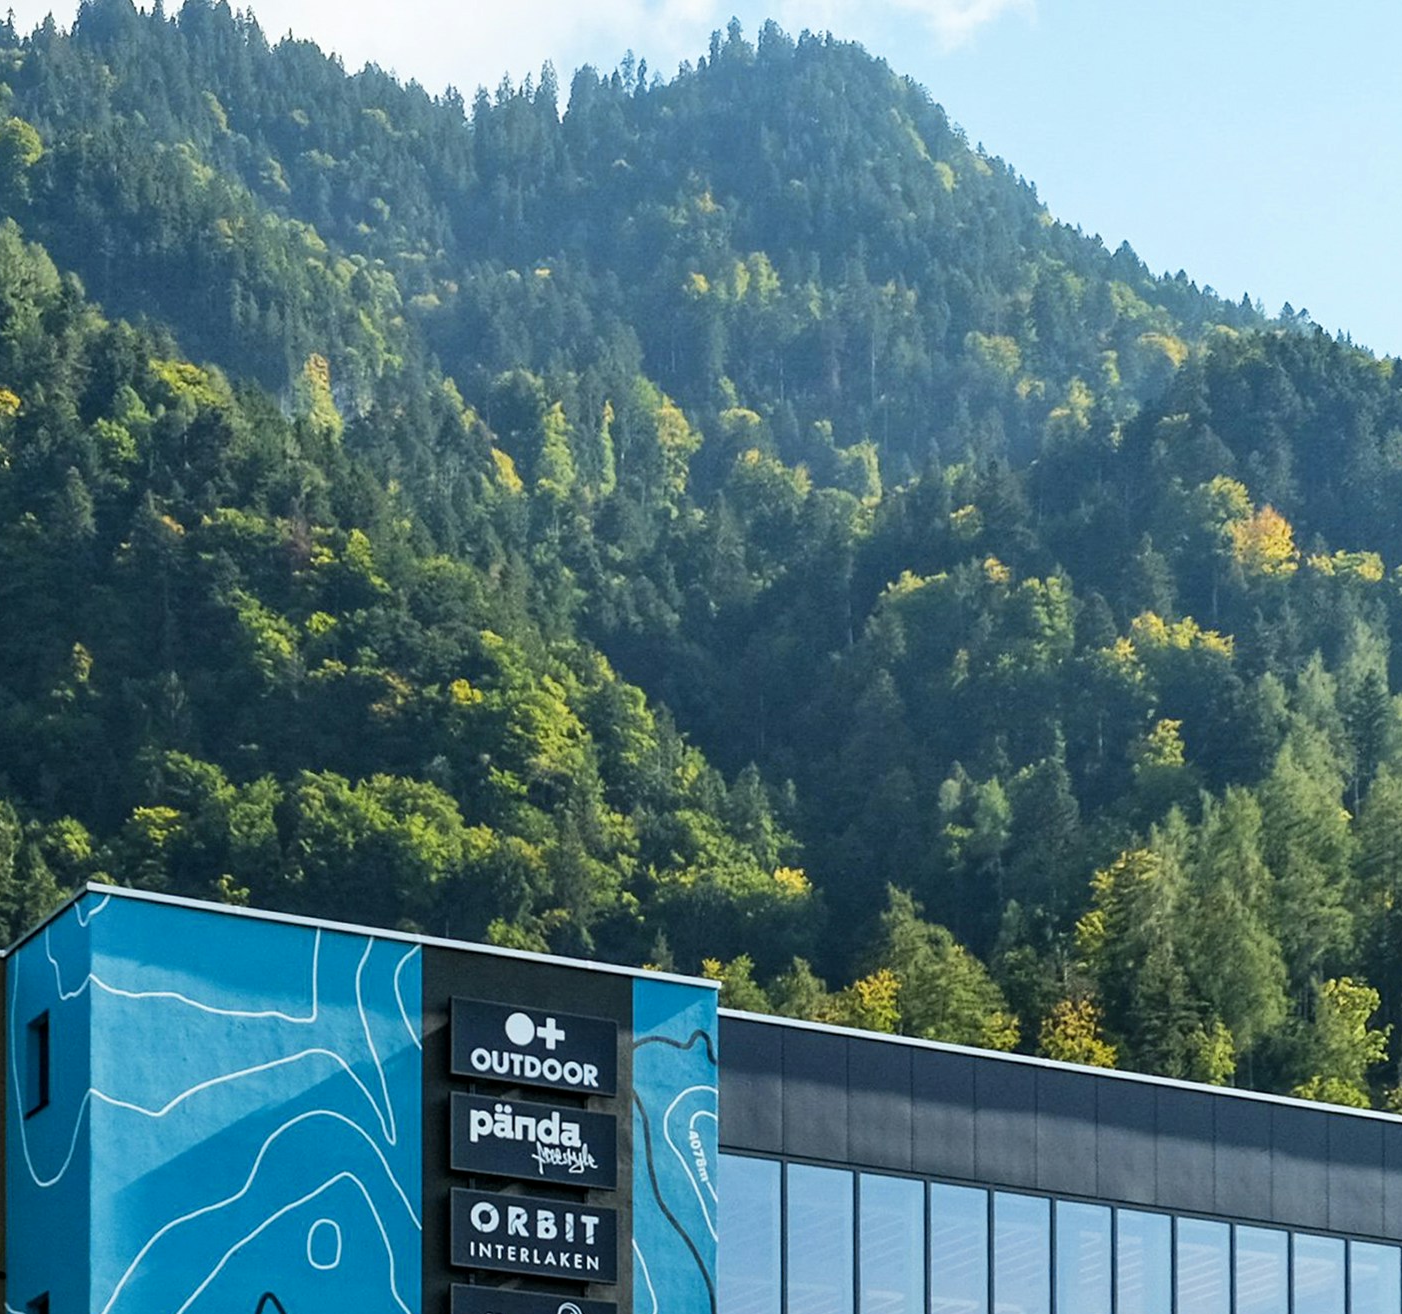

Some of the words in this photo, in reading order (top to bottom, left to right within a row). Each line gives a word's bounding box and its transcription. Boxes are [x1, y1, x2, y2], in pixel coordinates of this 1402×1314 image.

[470, 1047, 599, 1088] OUTDOOR
[470, 1103, 582, 1148] pända
[531, 1140, 598, 1175] freestyle
[470, 1201, 600, 1245] ORBIT
[470, 1241, 599, 1271] INTERLAKEN
